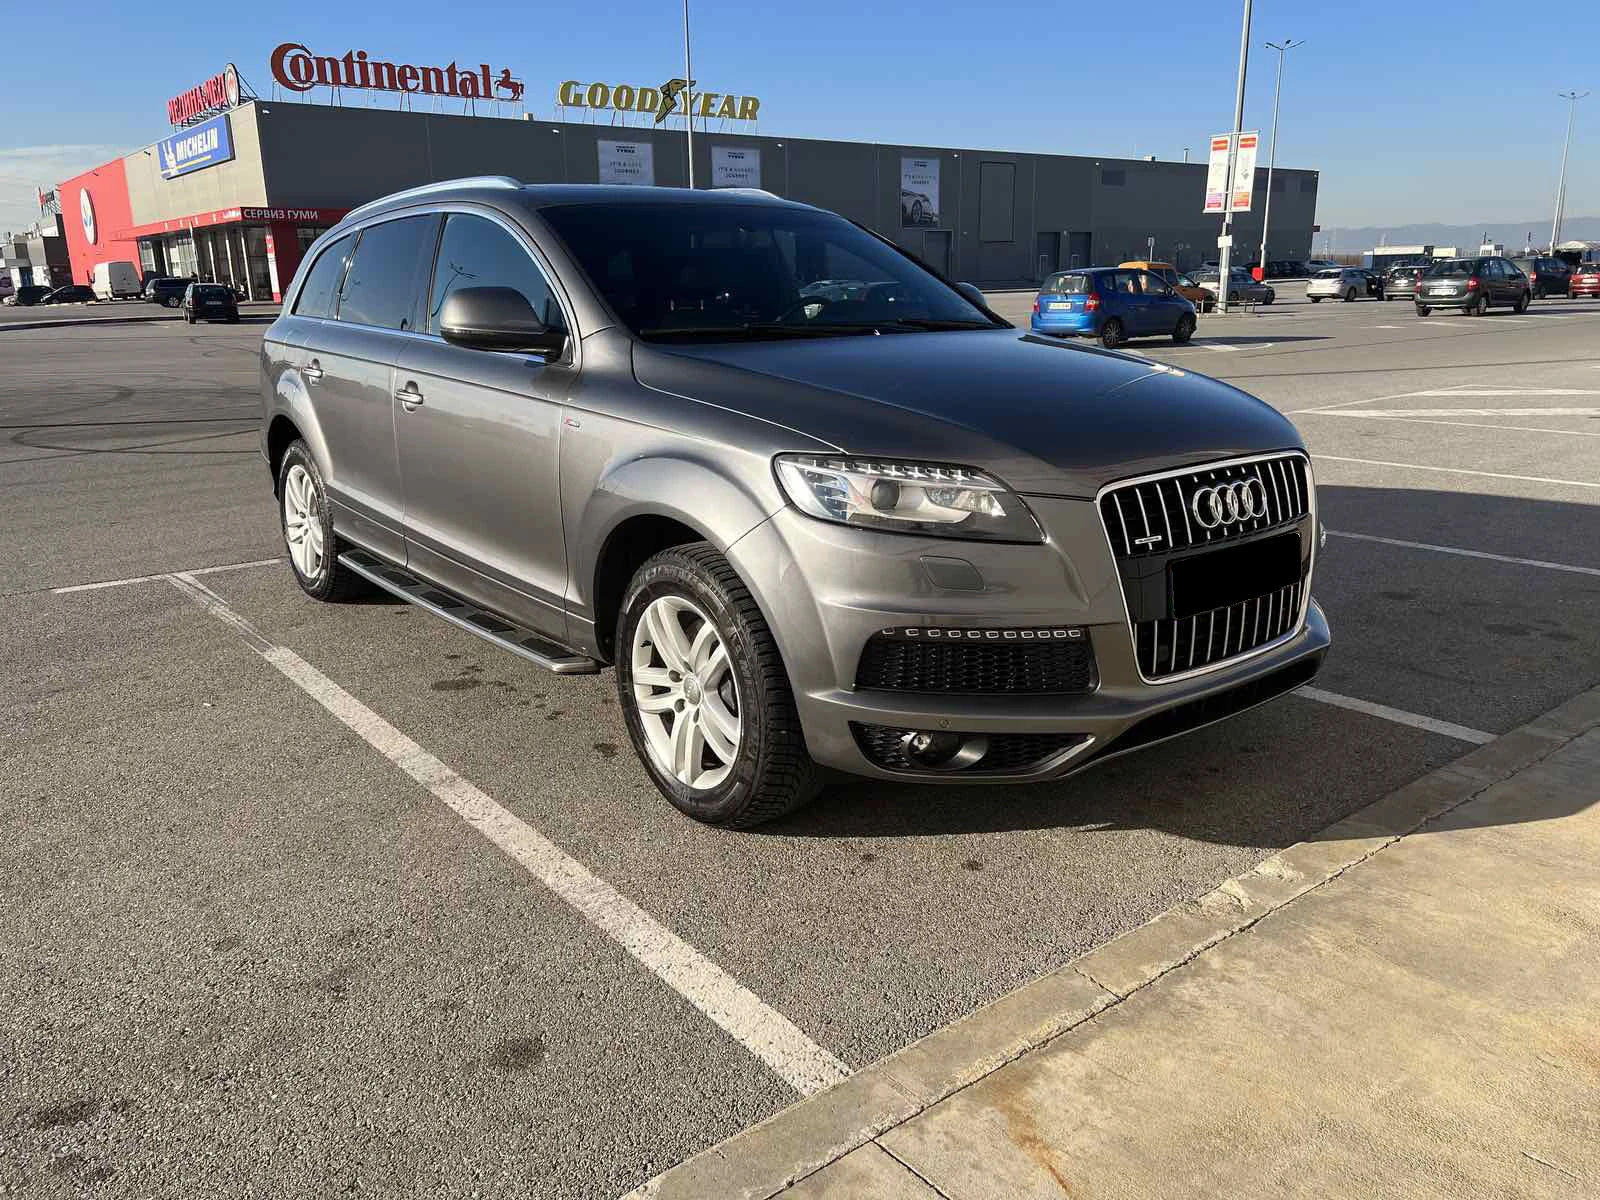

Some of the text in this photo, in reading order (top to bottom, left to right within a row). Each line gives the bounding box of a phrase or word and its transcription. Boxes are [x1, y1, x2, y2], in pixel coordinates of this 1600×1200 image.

[271, 43, 495, 99] Continental
[176, 128, 218, 162] MICHELIN
[243, 208, 285, 219] СЕРВИЗ
[287, 210, 319, 220] ГУМИ
